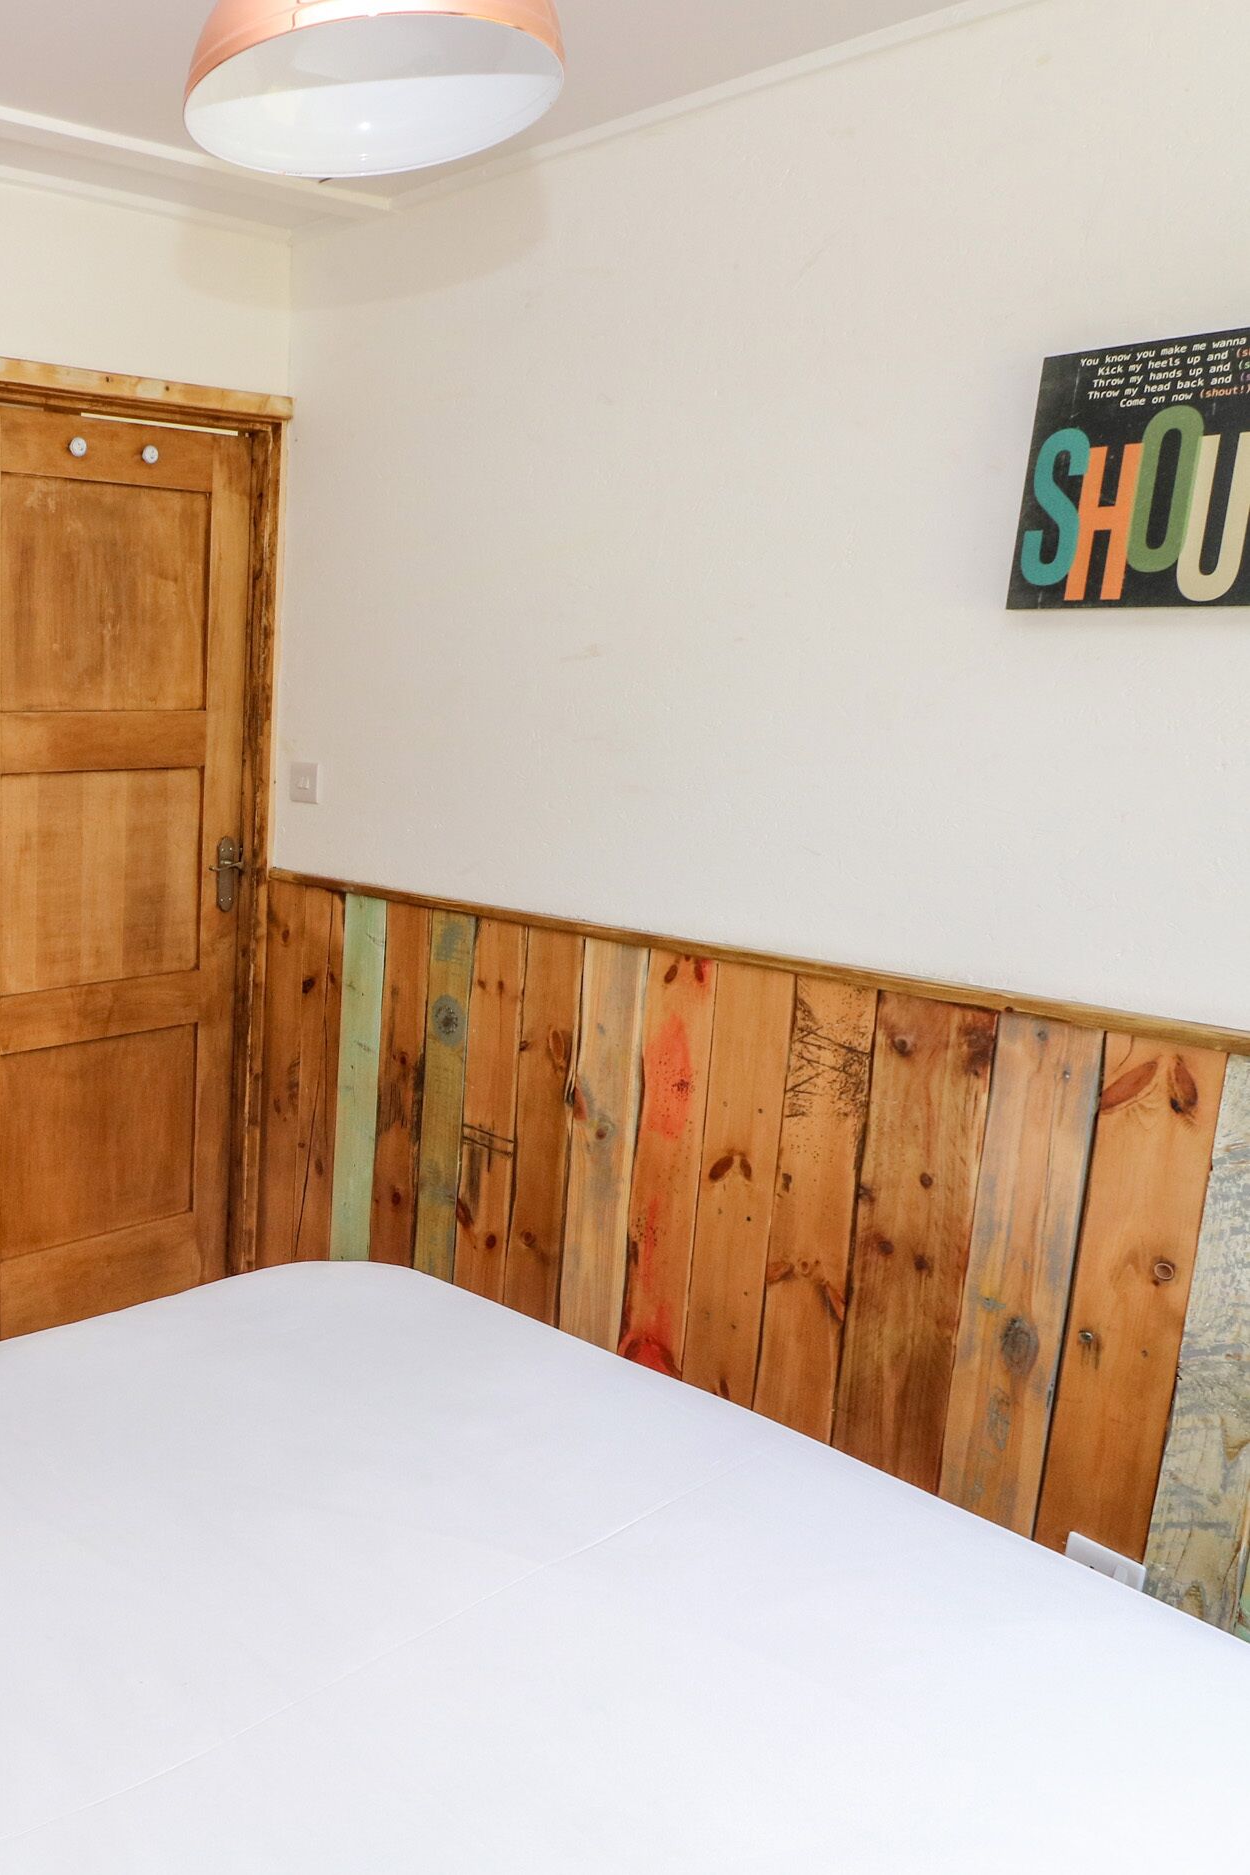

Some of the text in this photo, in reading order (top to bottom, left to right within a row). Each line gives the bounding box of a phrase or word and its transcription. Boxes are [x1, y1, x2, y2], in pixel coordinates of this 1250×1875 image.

[1080, 337, 1246, 367] You know you make me wanna
[1098, 365, 1123, 376] Kick
[1128, 363, 1142, 373] my
[1148, 359, 1180, 369] heels
[1187, 356, 1200, 365] up
[1207, 350, 1228, 361] and
[1088, 390, 1120, 400] Throw
[1125, 387, 1138, 397] my
[1144, 383, 1170, 393] head
[1177, 379, 1204, 390] back
[1211, 374, 1232, 386] and
[1092, 378, 1124, 388] Throw
[1130, 376, 1143, 386] my
[1150, 371, 1182, 381] hands
[1189, 367, 1203, 377] up
[1209, 362, 1230, 373] and
[1120, 398, 1146, 408] Come
[1152, 394, 1165, 404] on
[1172, 392, 1193, 402] now
